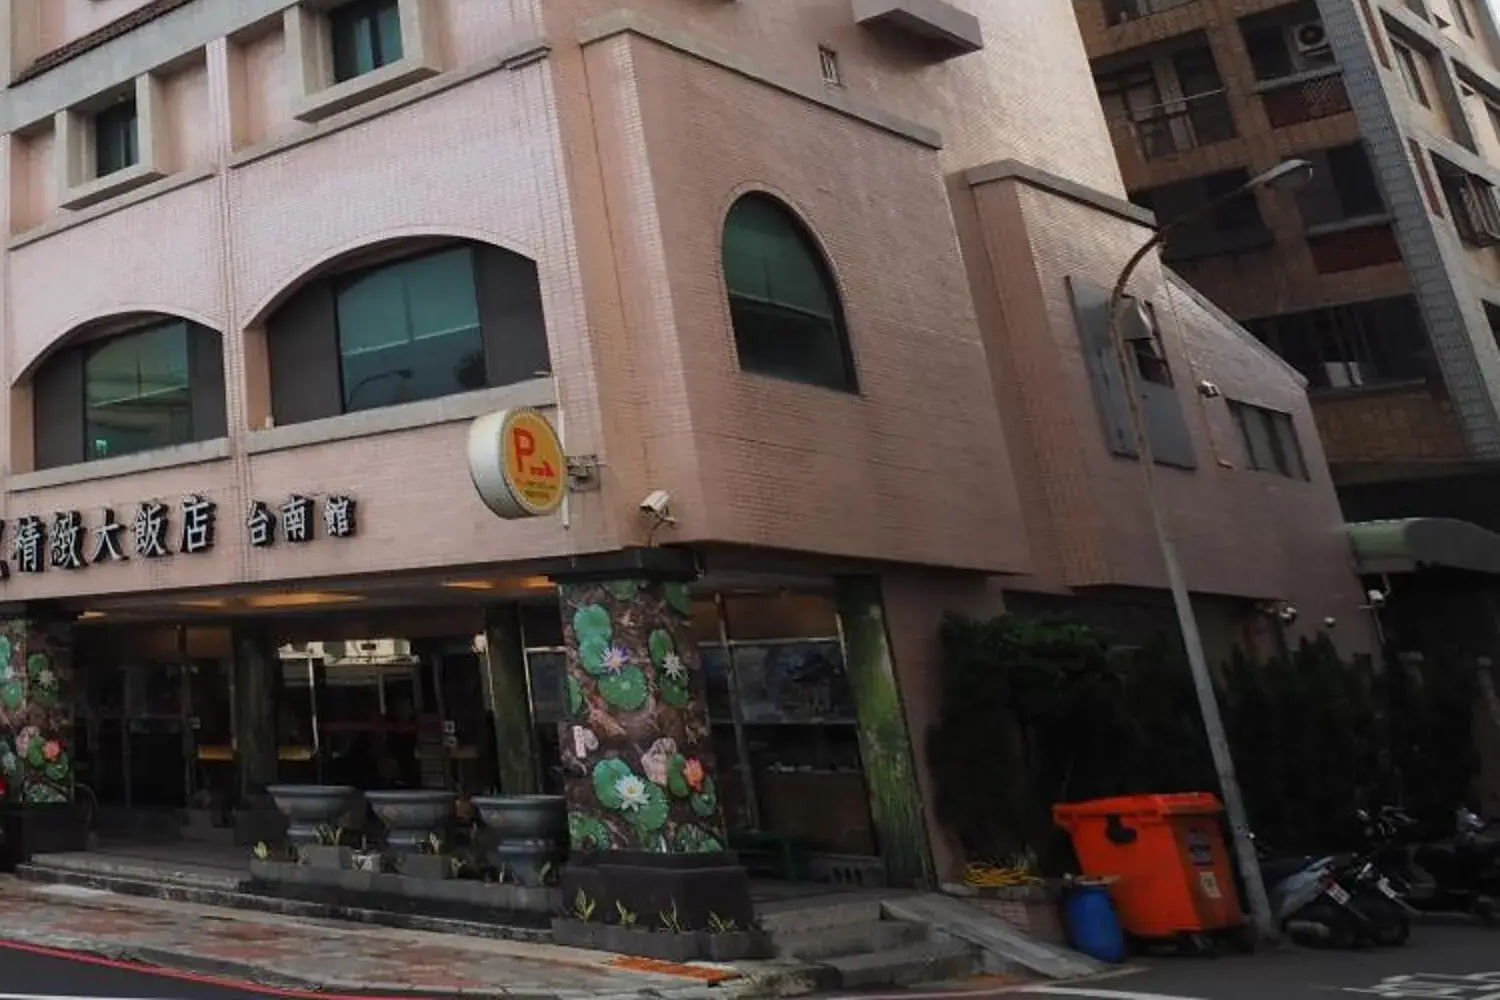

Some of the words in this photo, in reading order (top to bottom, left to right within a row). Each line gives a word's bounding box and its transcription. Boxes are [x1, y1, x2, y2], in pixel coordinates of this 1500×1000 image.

[513, 427, 536, 473] P
[248, 495, 355, 547] 台南館
